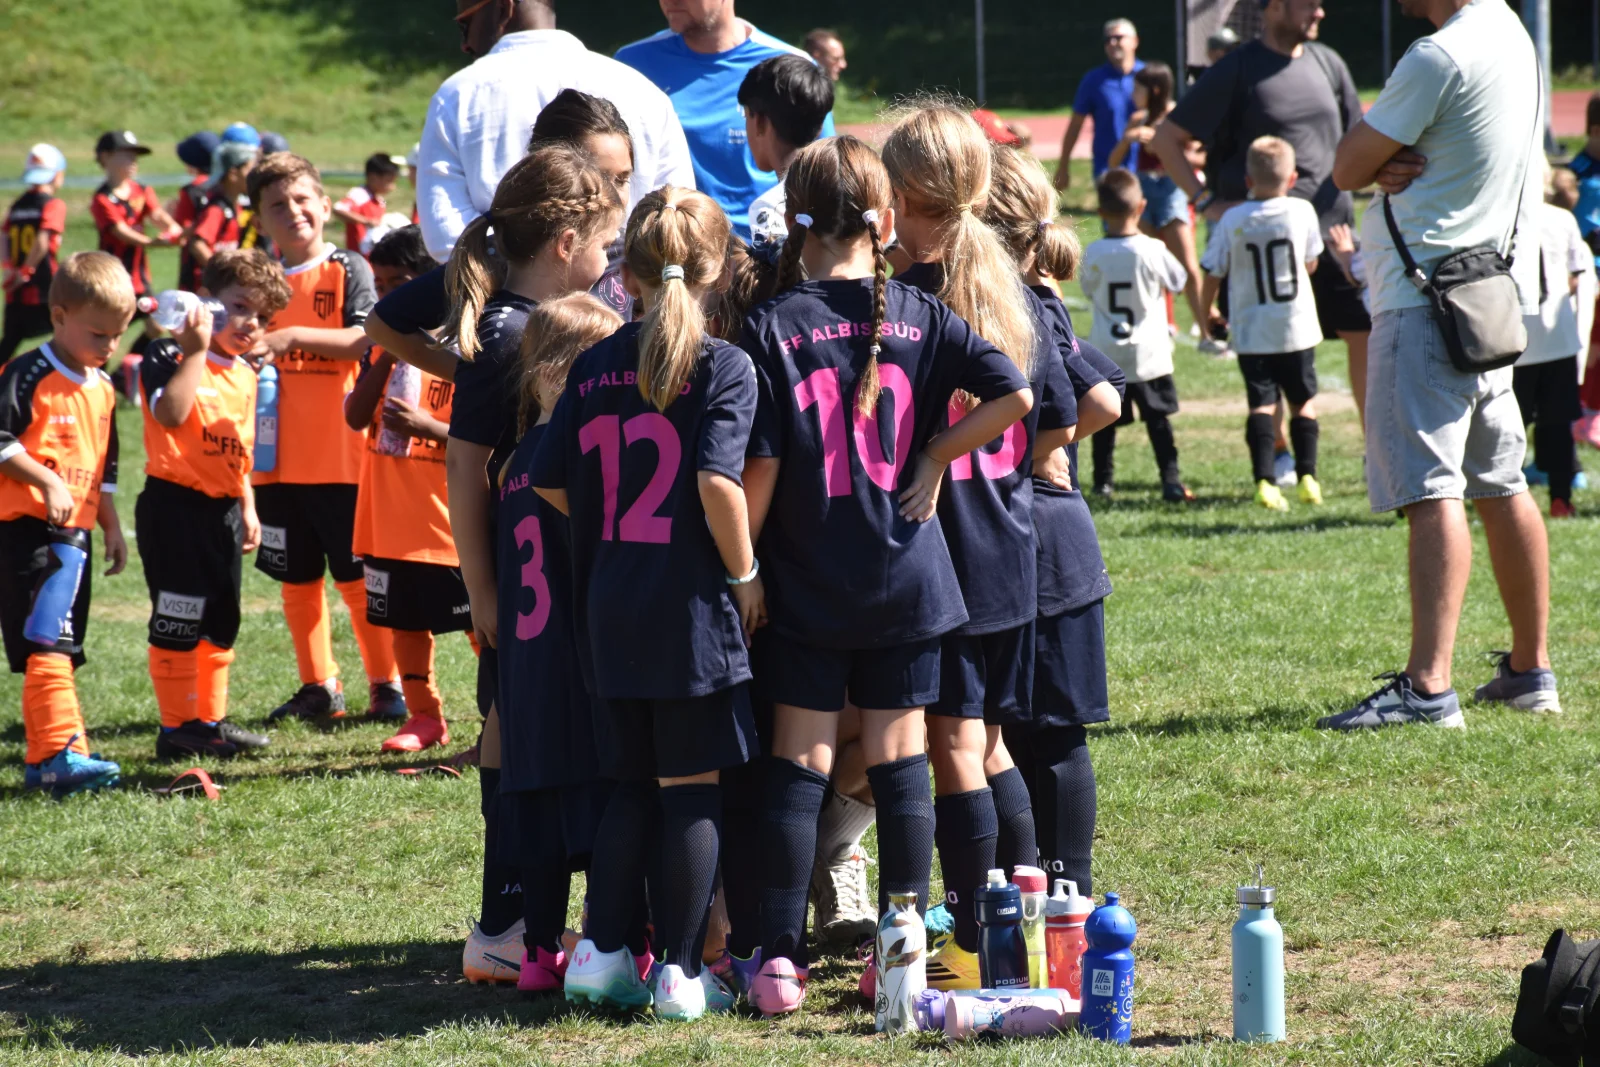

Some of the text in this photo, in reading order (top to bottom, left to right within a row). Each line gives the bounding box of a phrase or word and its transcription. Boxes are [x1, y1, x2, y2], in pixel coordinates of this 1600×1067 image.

[1245, 238, 1299, 305] 10
[1108, 282, 1135, 340] 5
[779, 321, 923, 356] FF ALBIS SÜD
[578, 378, 596, 398] FF
[793, 363, 915, 498] 10
[578, 411, 682, 544] 12
[513, 514, 552, 641] 3
[156, 619, 200, 636] OPTIC
[163, 598, 199, 616] VISTA
[995, 976, 1030, 986] PODIUM
